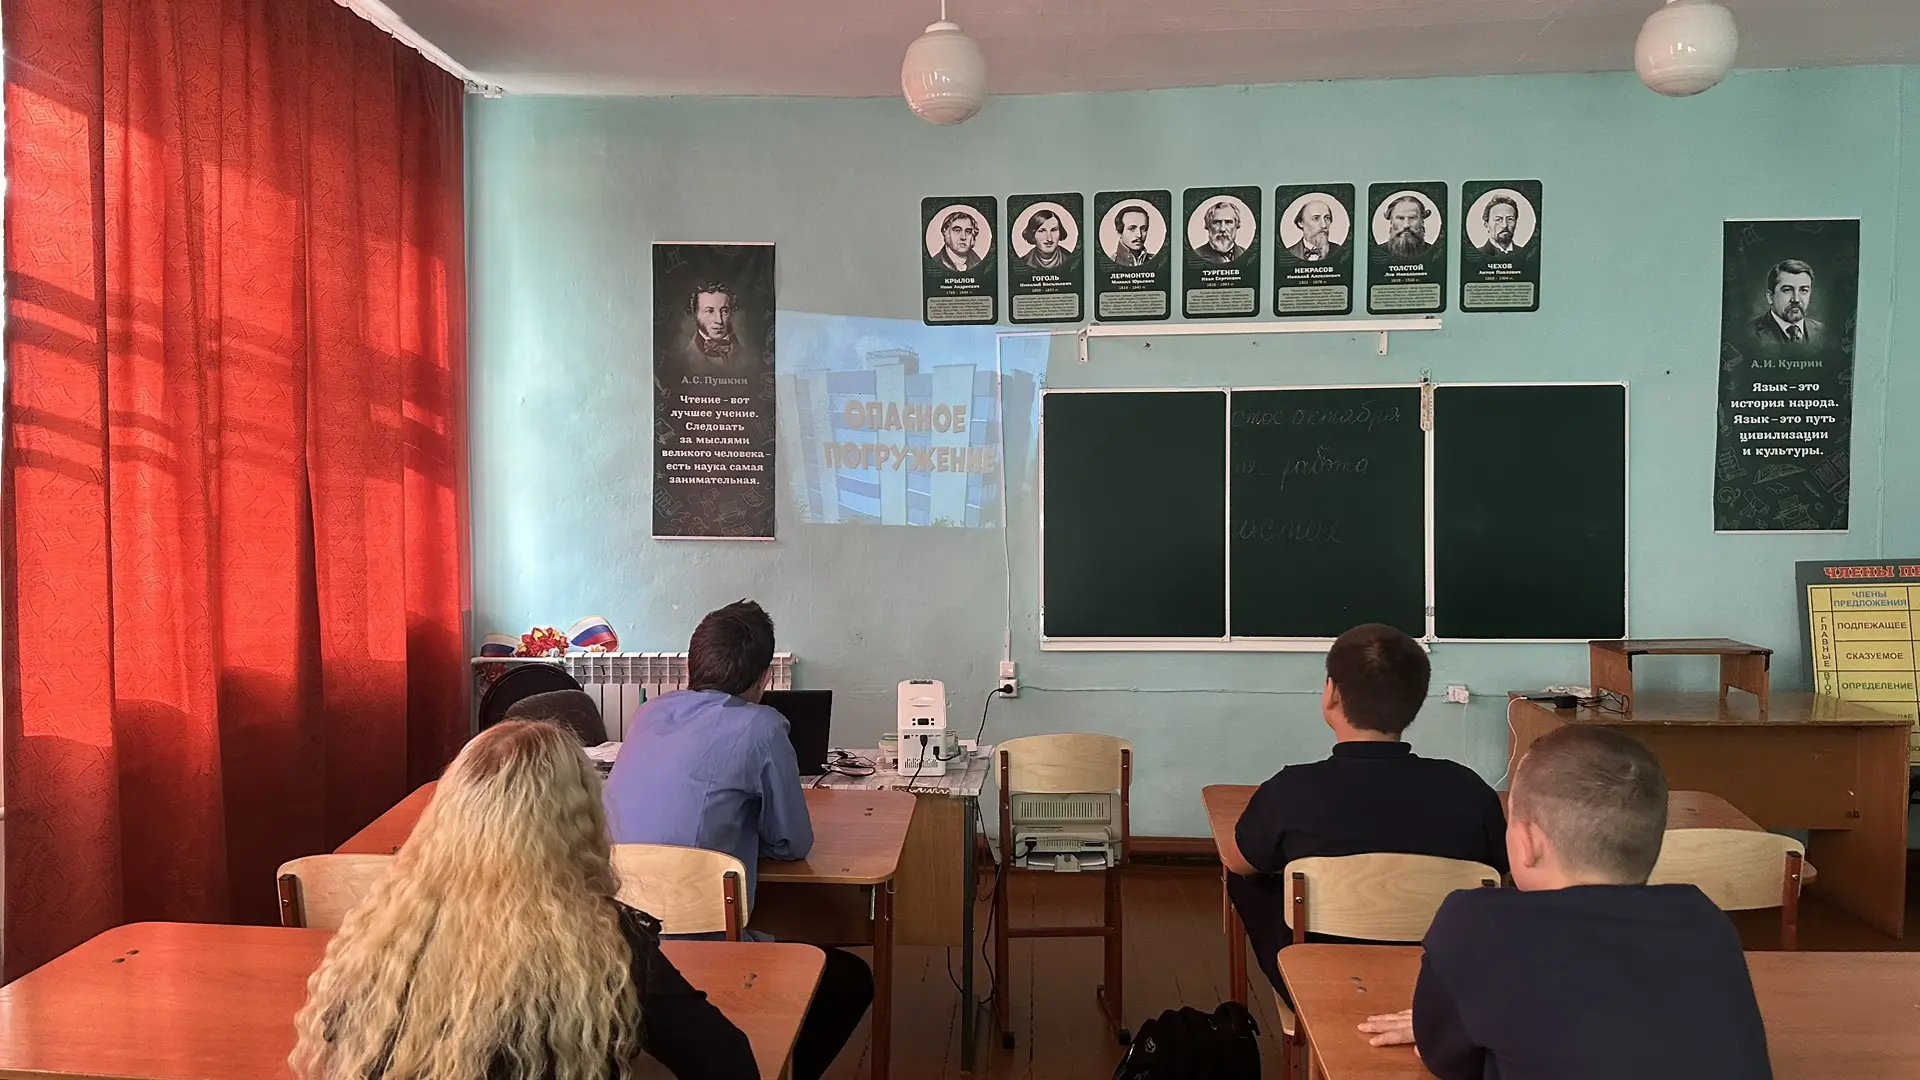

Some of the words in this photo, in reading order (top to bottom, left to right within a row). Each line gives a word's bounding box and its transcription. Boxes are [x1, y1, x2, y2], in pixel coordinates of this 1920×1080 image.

[1294, 266, 1334, 274] НЕКРАСОВ
[1388, 263, 1424, 272] ТОЛСТОЙ
[1487, 262, 1513, 270] ЧЕХОВ
[1751, 359, 1776, 368] А.И.
[1778, 359, 1823, 370] Куприн
[681, 376, 703, 384] А.С.
[704, 376, 748, 386] Пушкин
[1752, 382, 1788, 392] Язык
[1798, 383, 1820, 391] это
[680, 395, 721, 404] Чтение
[1730, 399, 1785, 410] история
[1789, 399, 1839, 410] народа.
[670, 409, 712, 419] лучшее
[715, 410, 759, 419] учение.
[845, 400, 967, 434] ОПАСНОЕ
[1733, 414, 1770, 424] Язык
[1779, 415, 1801, 423] это
[1805, 415, 1836, 425] путь
[685, 421, 745, 432] Следовать
[696, 437, 750, 445] мыслями
[1739, 431, 1829, 442] цивилизации
[661, 450, 712, 458] великого
[1742, 448, 1751, 456] и
[1755, 447, 1824, 458] культуры.
[824, 441, 996, 474] ПОГРУЖЕНИЕ
[694, 463, 726, 472] наука
[729, 463, 764, 471] самая
[669, 476, 760, 485] занимательная.
[1824, 565, 1895, 579] ЧЛЕНЫ
[1851, 590, 1887, 598] ЧЛЕНЫ
[1833, 599, 1907, 608] ПРЕДЛОЖЕНИЯ
[1837, 621, 1907, 630] ПОДЛЕЖАЩЕЕ
[1820, 616, 1831, 667] ГЛАВНЫЕ
[1845, 652, 1904, 660] СКАЗУЕМОЕ
[1841, 682, 1914, 691] ОПРЕДЕЛЕНИЕ
